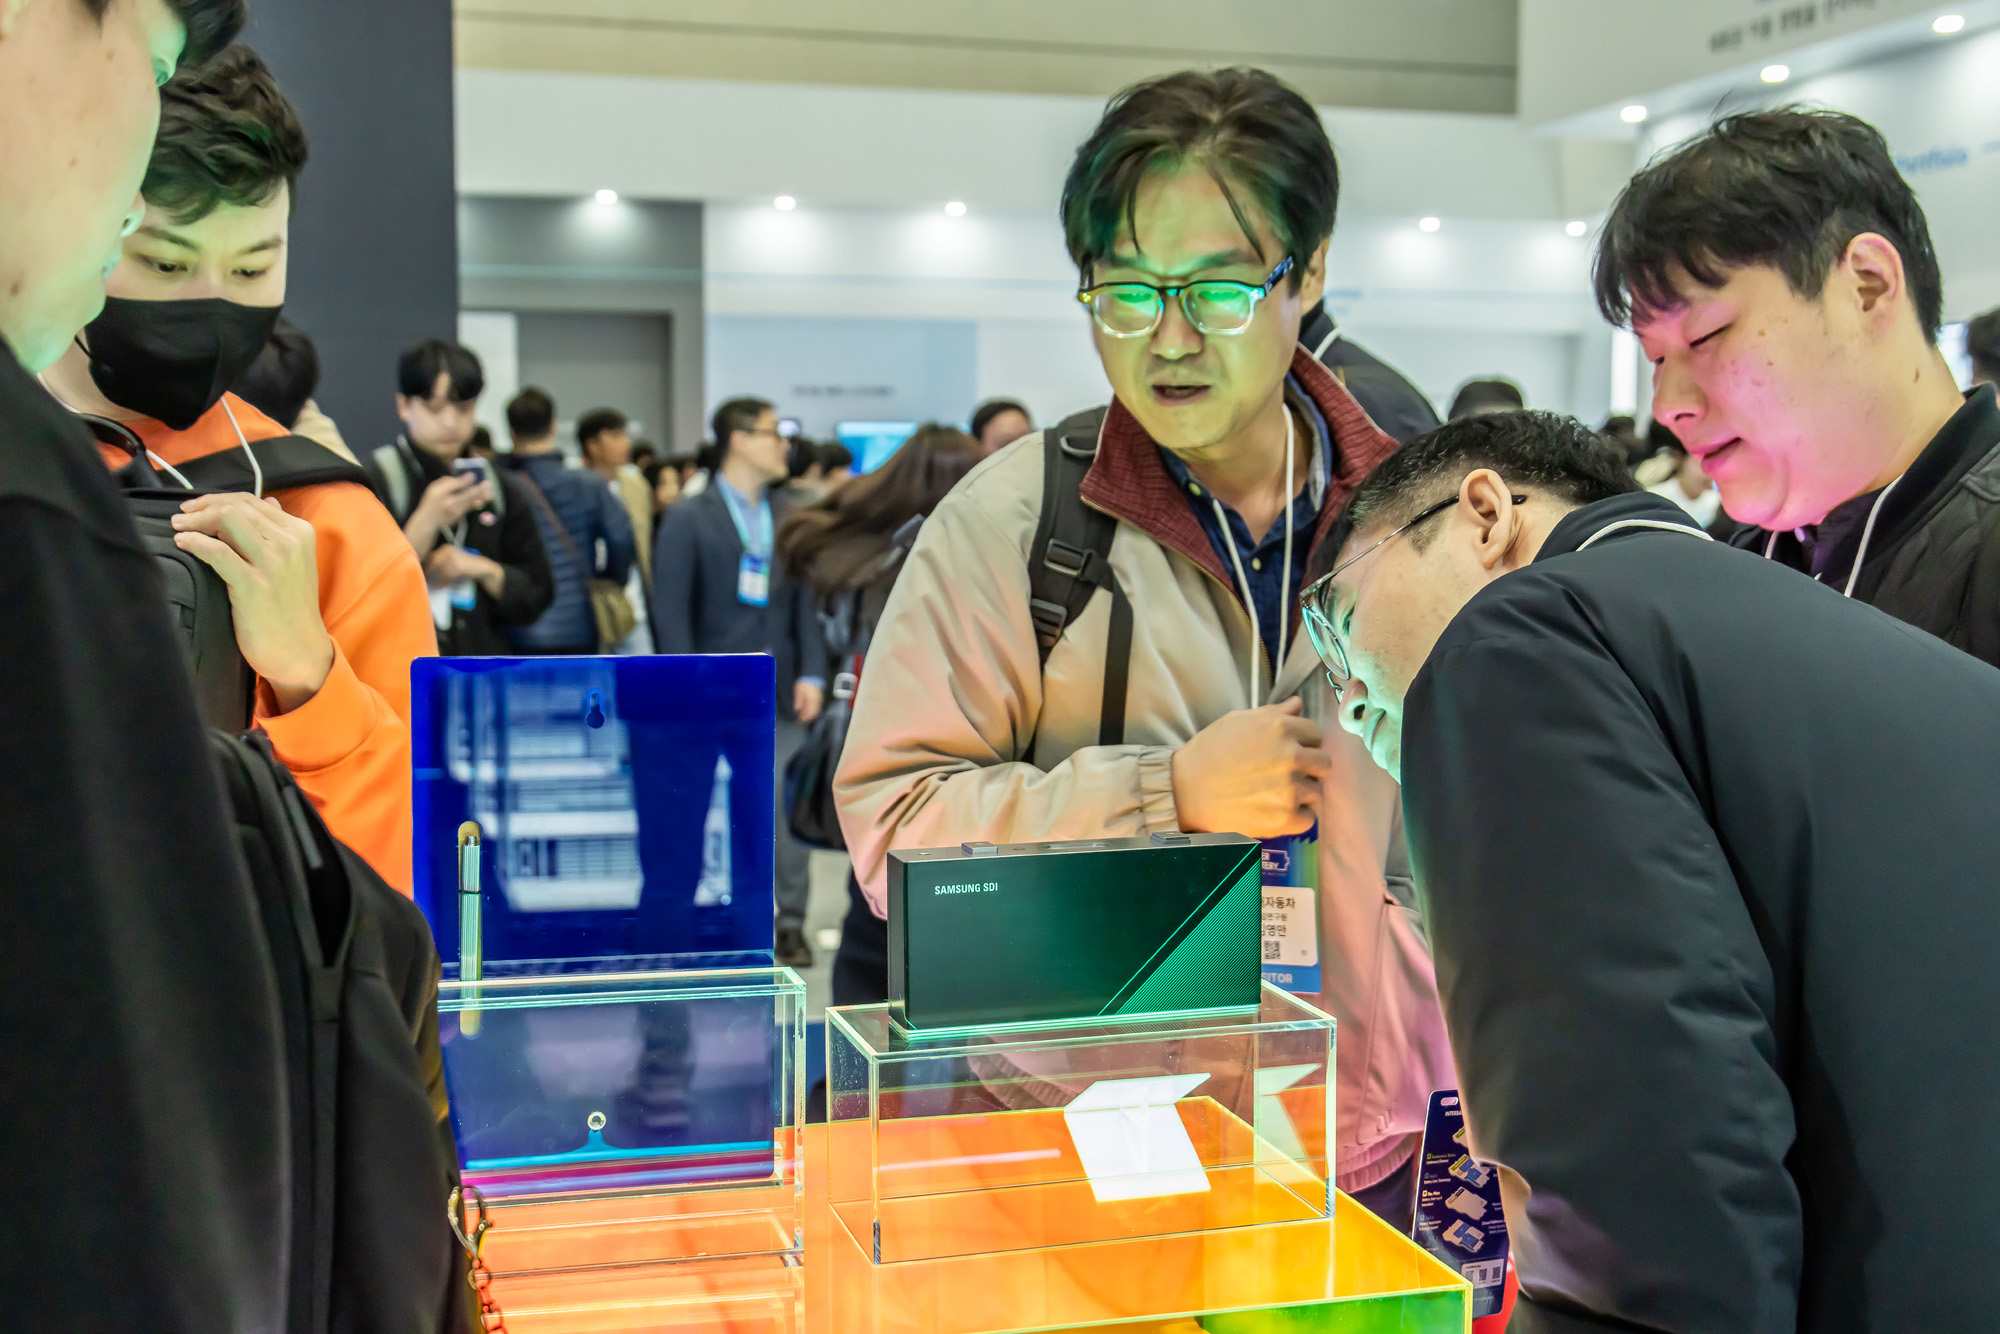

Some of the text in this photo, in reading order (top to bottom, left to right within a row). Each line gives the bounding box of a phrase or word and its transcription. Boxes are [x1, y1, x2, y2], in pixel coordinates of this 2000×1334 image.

[934, 882, 998, 895] SAMSUNG SDI
[1262, 896, 1296, 909] 자동차
[1261, 972, 1293, 984] SITOR
